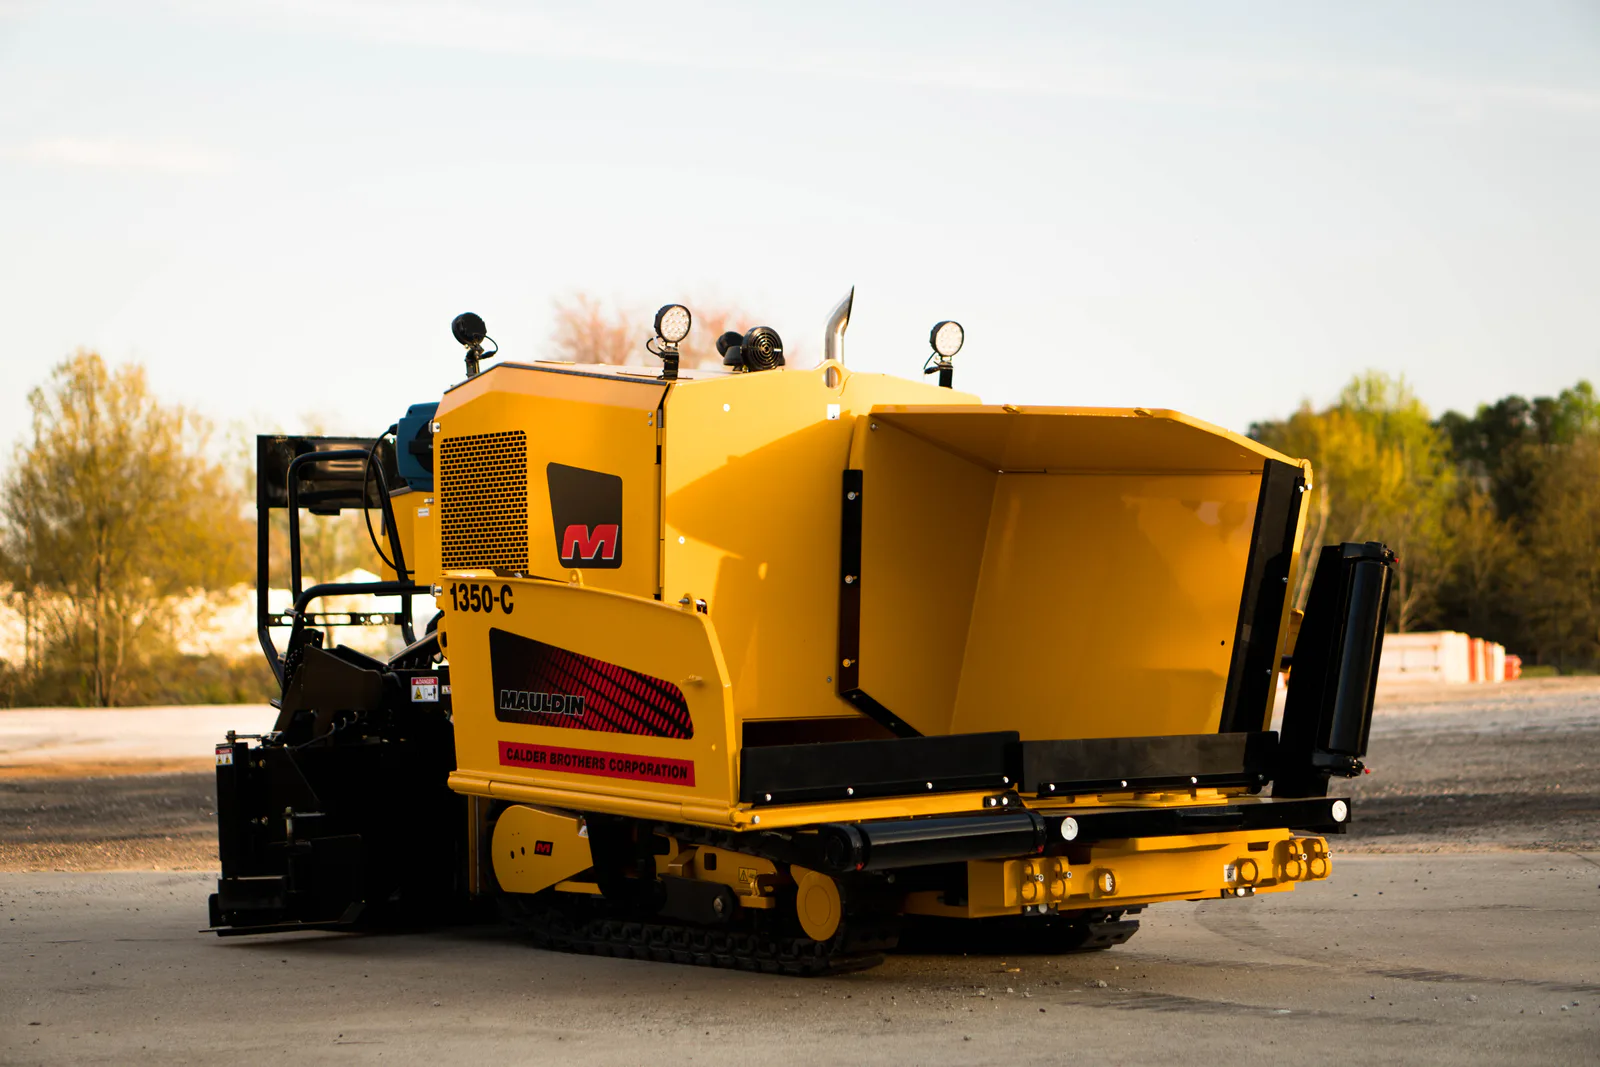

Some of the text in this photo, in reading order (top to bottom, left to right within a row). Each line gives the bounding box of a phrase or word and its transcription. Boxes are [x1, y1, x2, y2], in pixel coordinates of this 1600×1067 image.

[561, 524, 619, 560] M
[450, 582, 514, 614] 1350-C
[500, 689, 586, 717] MAULDIN
[506, 747, 688, 780] CALDER BROTHERS CORPORATION
